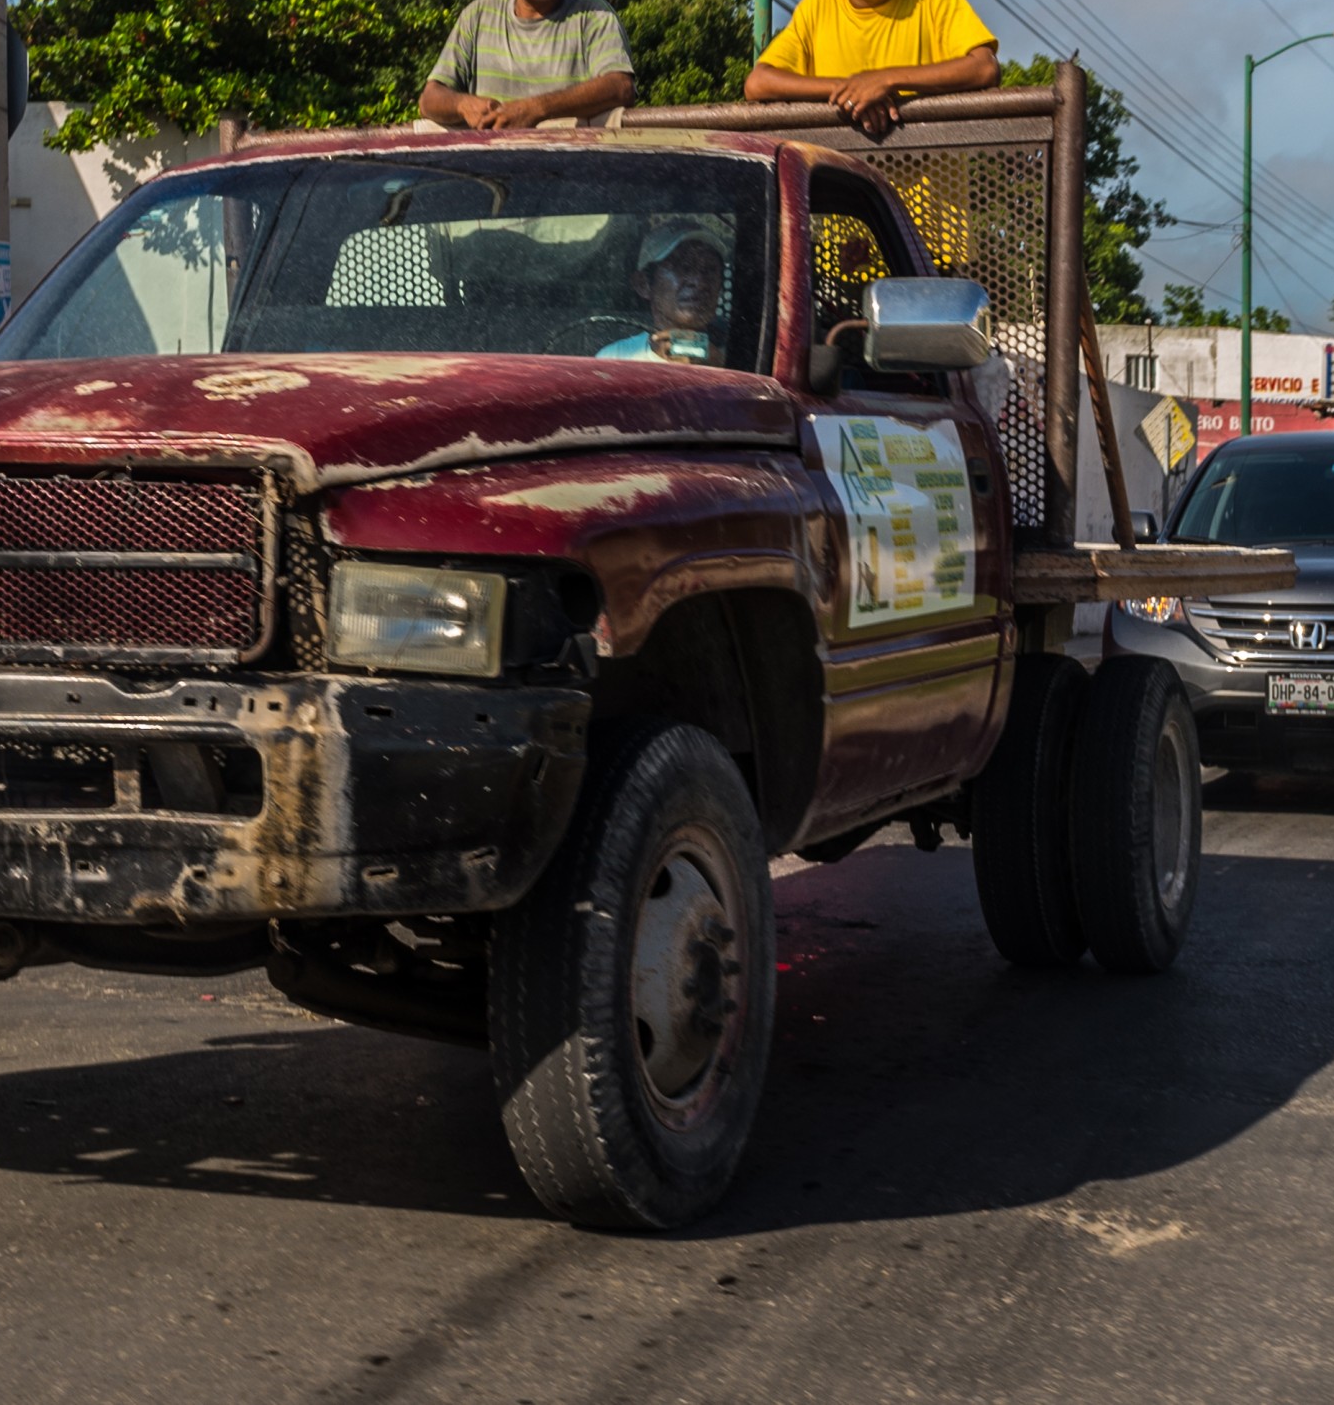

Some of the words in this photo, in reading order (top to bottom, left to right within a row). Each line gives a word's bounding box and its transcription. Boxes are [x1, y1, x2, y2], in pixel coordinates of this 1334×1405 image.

[1197, 415, 1224, 431] ERO
[1229, 416, 1275, 432] BITO
[1289, 672, 1323, 680] HONDA
